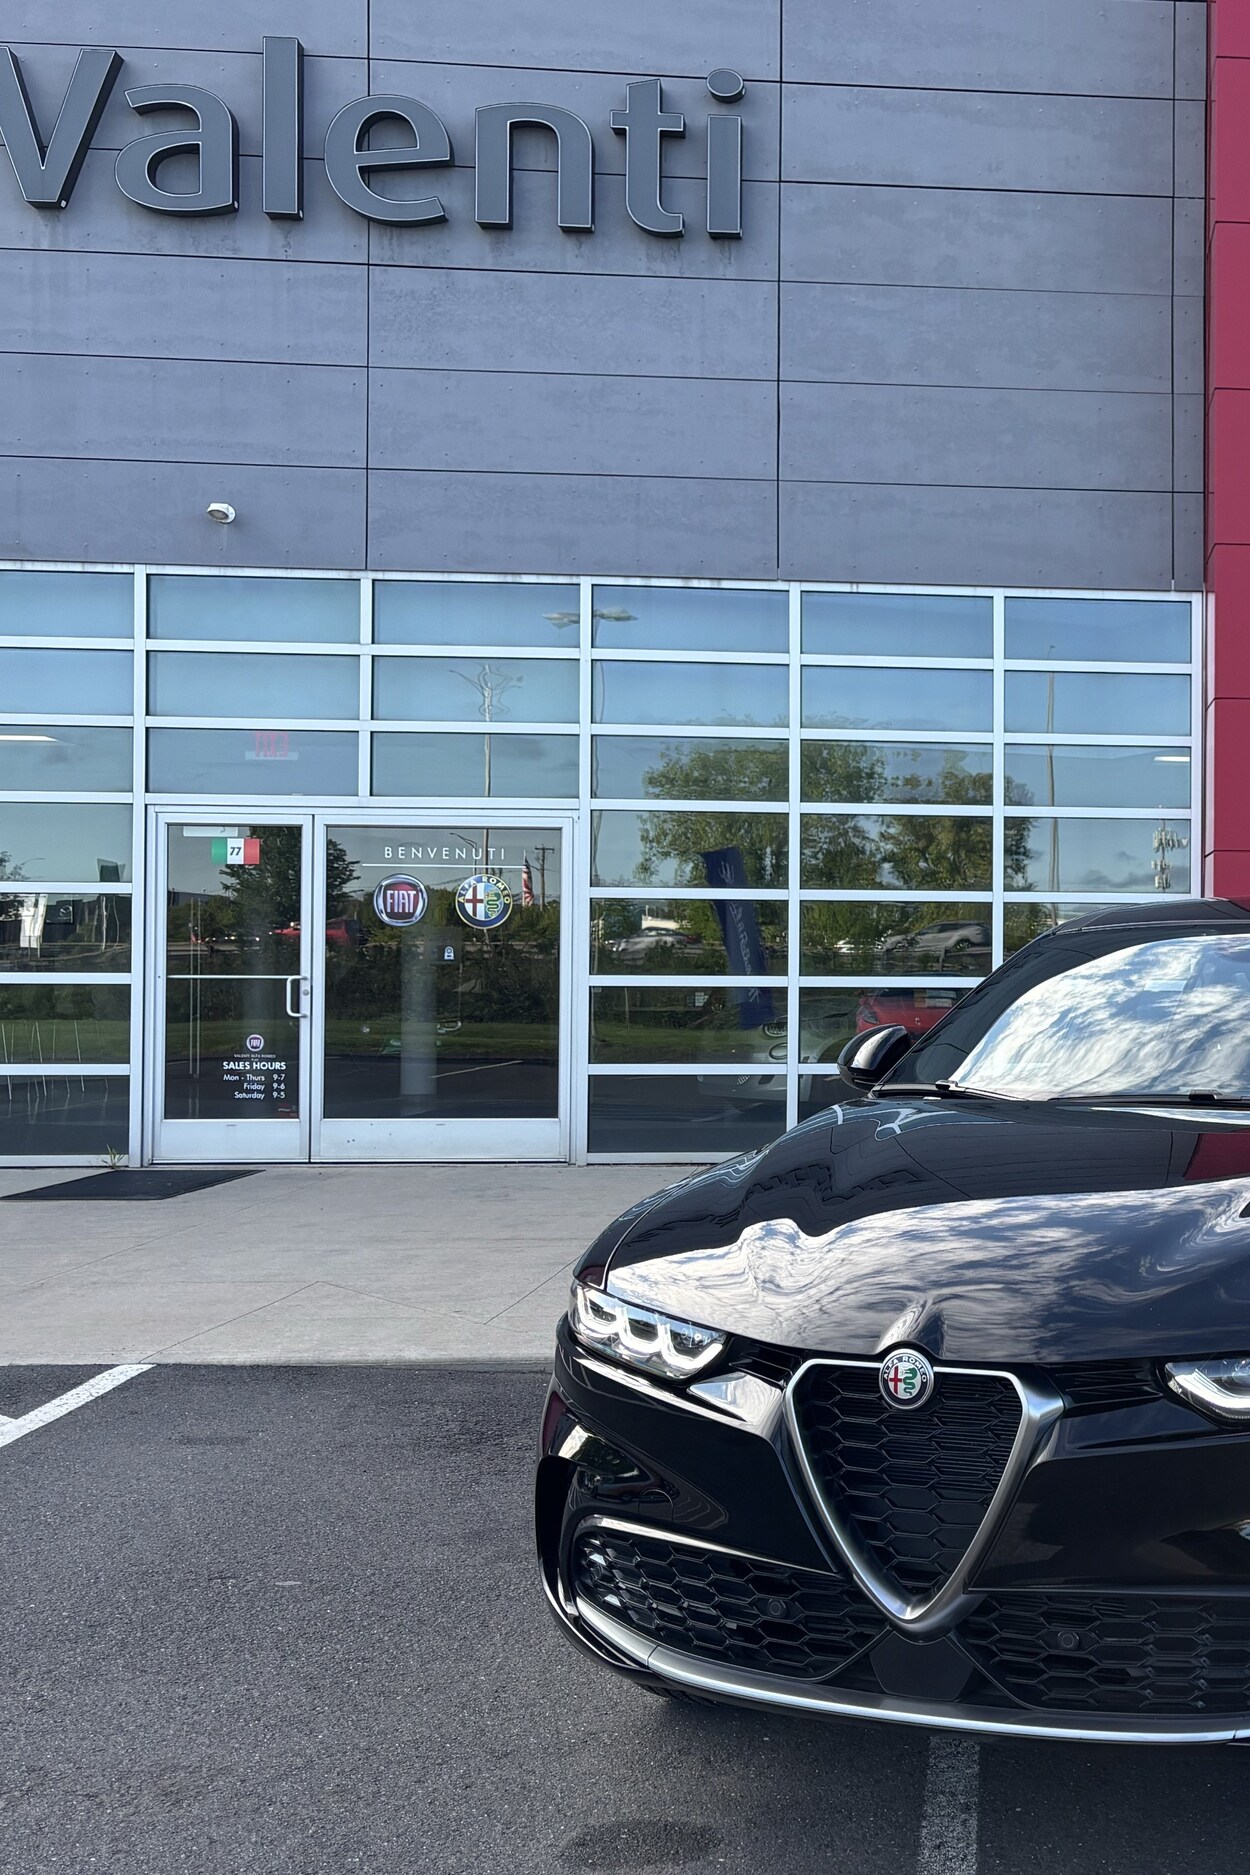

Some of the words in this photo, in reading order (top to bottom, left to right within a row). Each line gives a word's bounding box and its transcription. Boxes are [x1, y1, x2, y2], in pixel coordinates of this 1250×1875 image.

[0, 36, 746, 240] Valenti
[229, 846, 242, 856] 77
[384, 846, 505, 860] BENVENUTI
[458, 879, 477, 903] ALFA
[482, 876, 511, 904] ROMEO
[386, 889, 417, 913] FIAT
[223, 1061, 250, 1070] SALES
[253, 1061, 286, 1070] HOURS
[272, 1073, 286, 1081] 9-7
[243, 1082, 265, 1091] Friday
[272, 1082, 286, 1090] 9-6
[234, 1091, 265, 1100] Saturday
[272, 1091, 286, 1099] 9-5
[884, 1358, 899, 1379] ALFA
[902, 1356, 927, 1382] ROMEO
